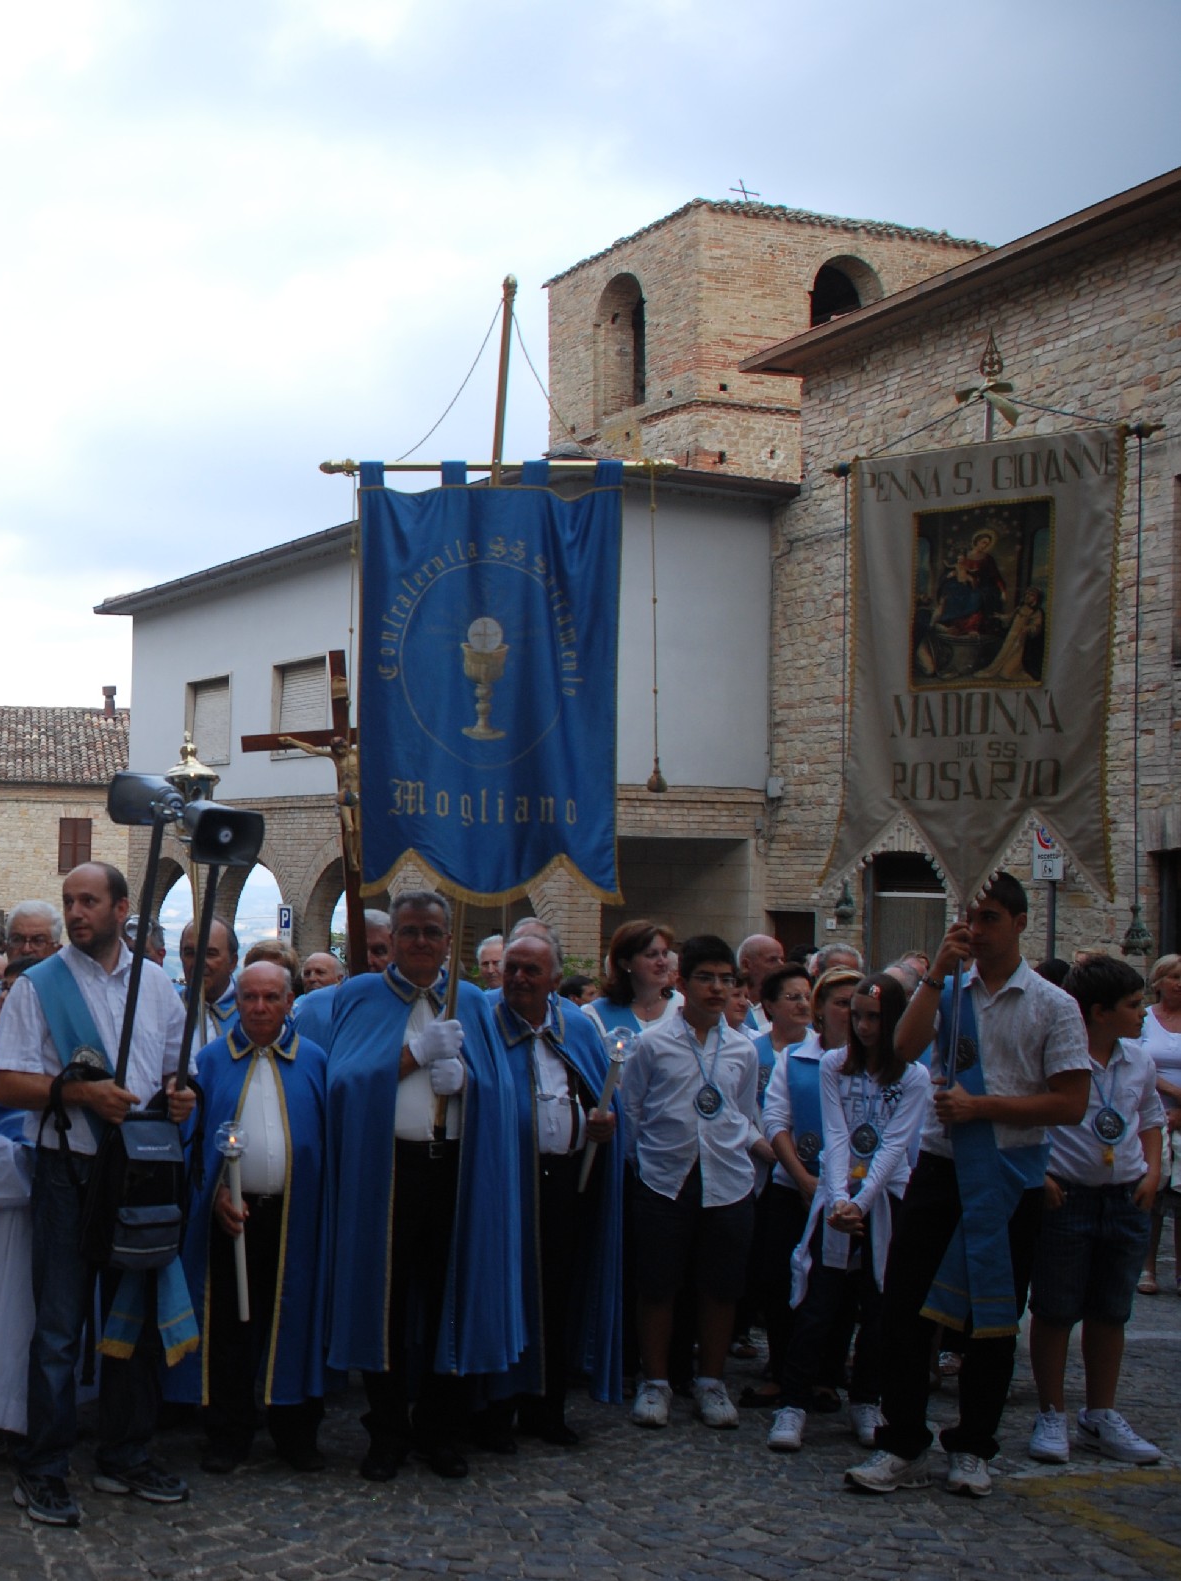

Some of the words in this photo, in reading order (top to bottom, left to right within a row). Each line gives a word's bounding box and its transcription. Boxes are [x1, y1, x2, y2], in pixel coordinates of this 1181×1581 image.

[862, 467, 942, 502] PENNA
[953, 461, 981, 496] S.
[890, 690, 1065, 738] MADONNA
[956, 740, 979, 759] DEL
[986, 741, 1025, 759] SS.
[888, 759, 1062, 801] ROSARIO
[388, 778, 577, 827] Mogliano
[281, 909, 289, 927] P
